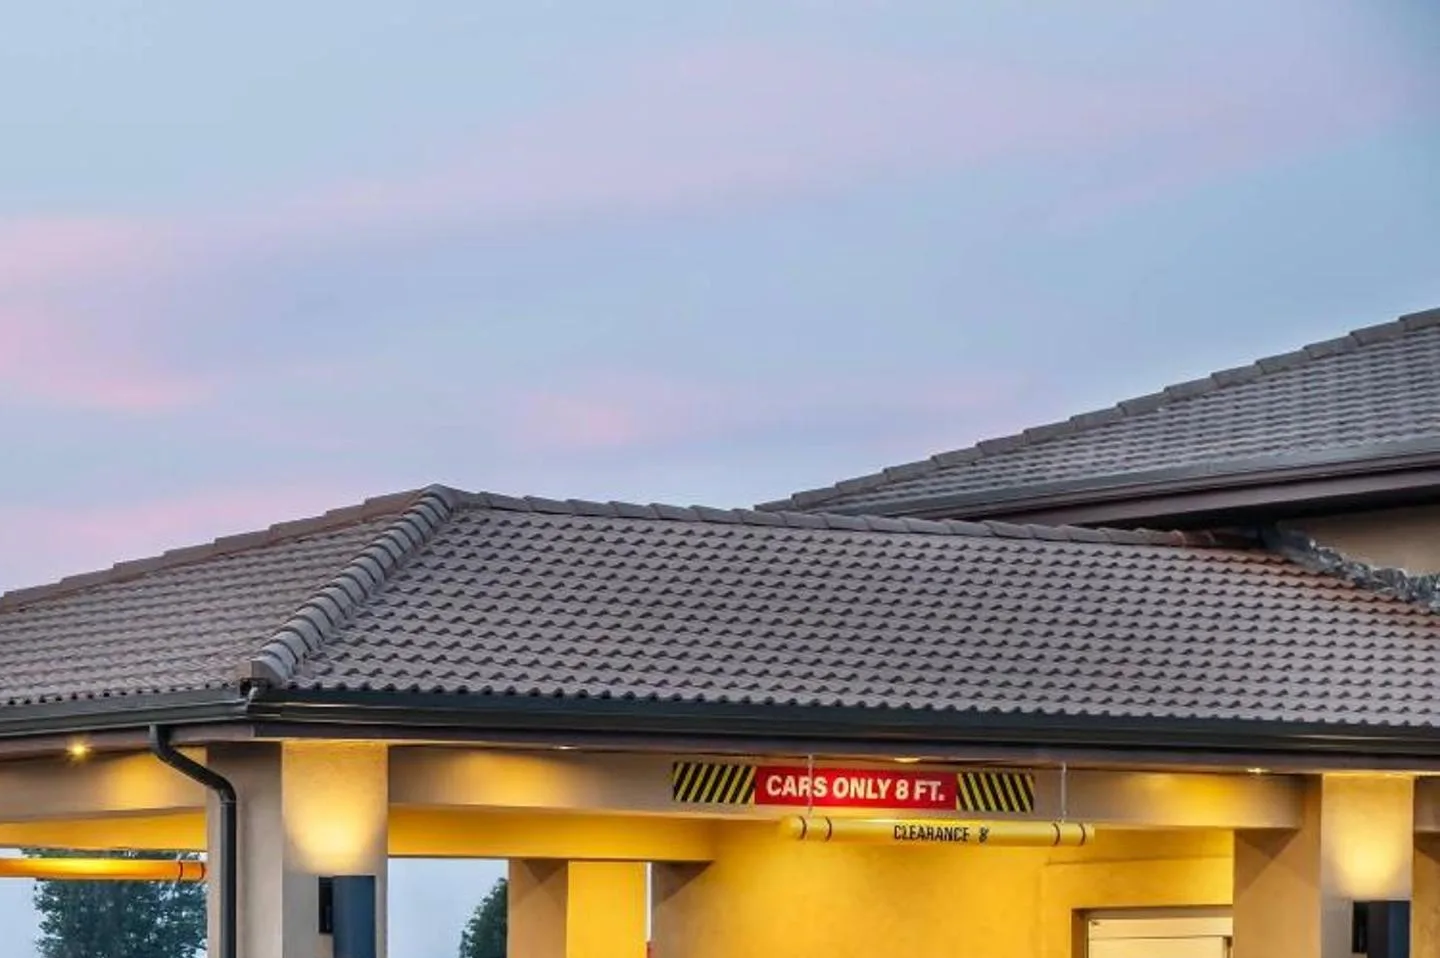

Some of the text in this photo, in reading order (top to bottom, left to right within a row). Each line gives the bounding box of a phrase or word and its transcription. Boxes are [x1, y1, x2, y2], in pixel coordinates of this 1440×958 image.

[766, 775, 945, 801] CARS ONLY 8 FT.
[894, 825, 970, 841] CLEARANCE
